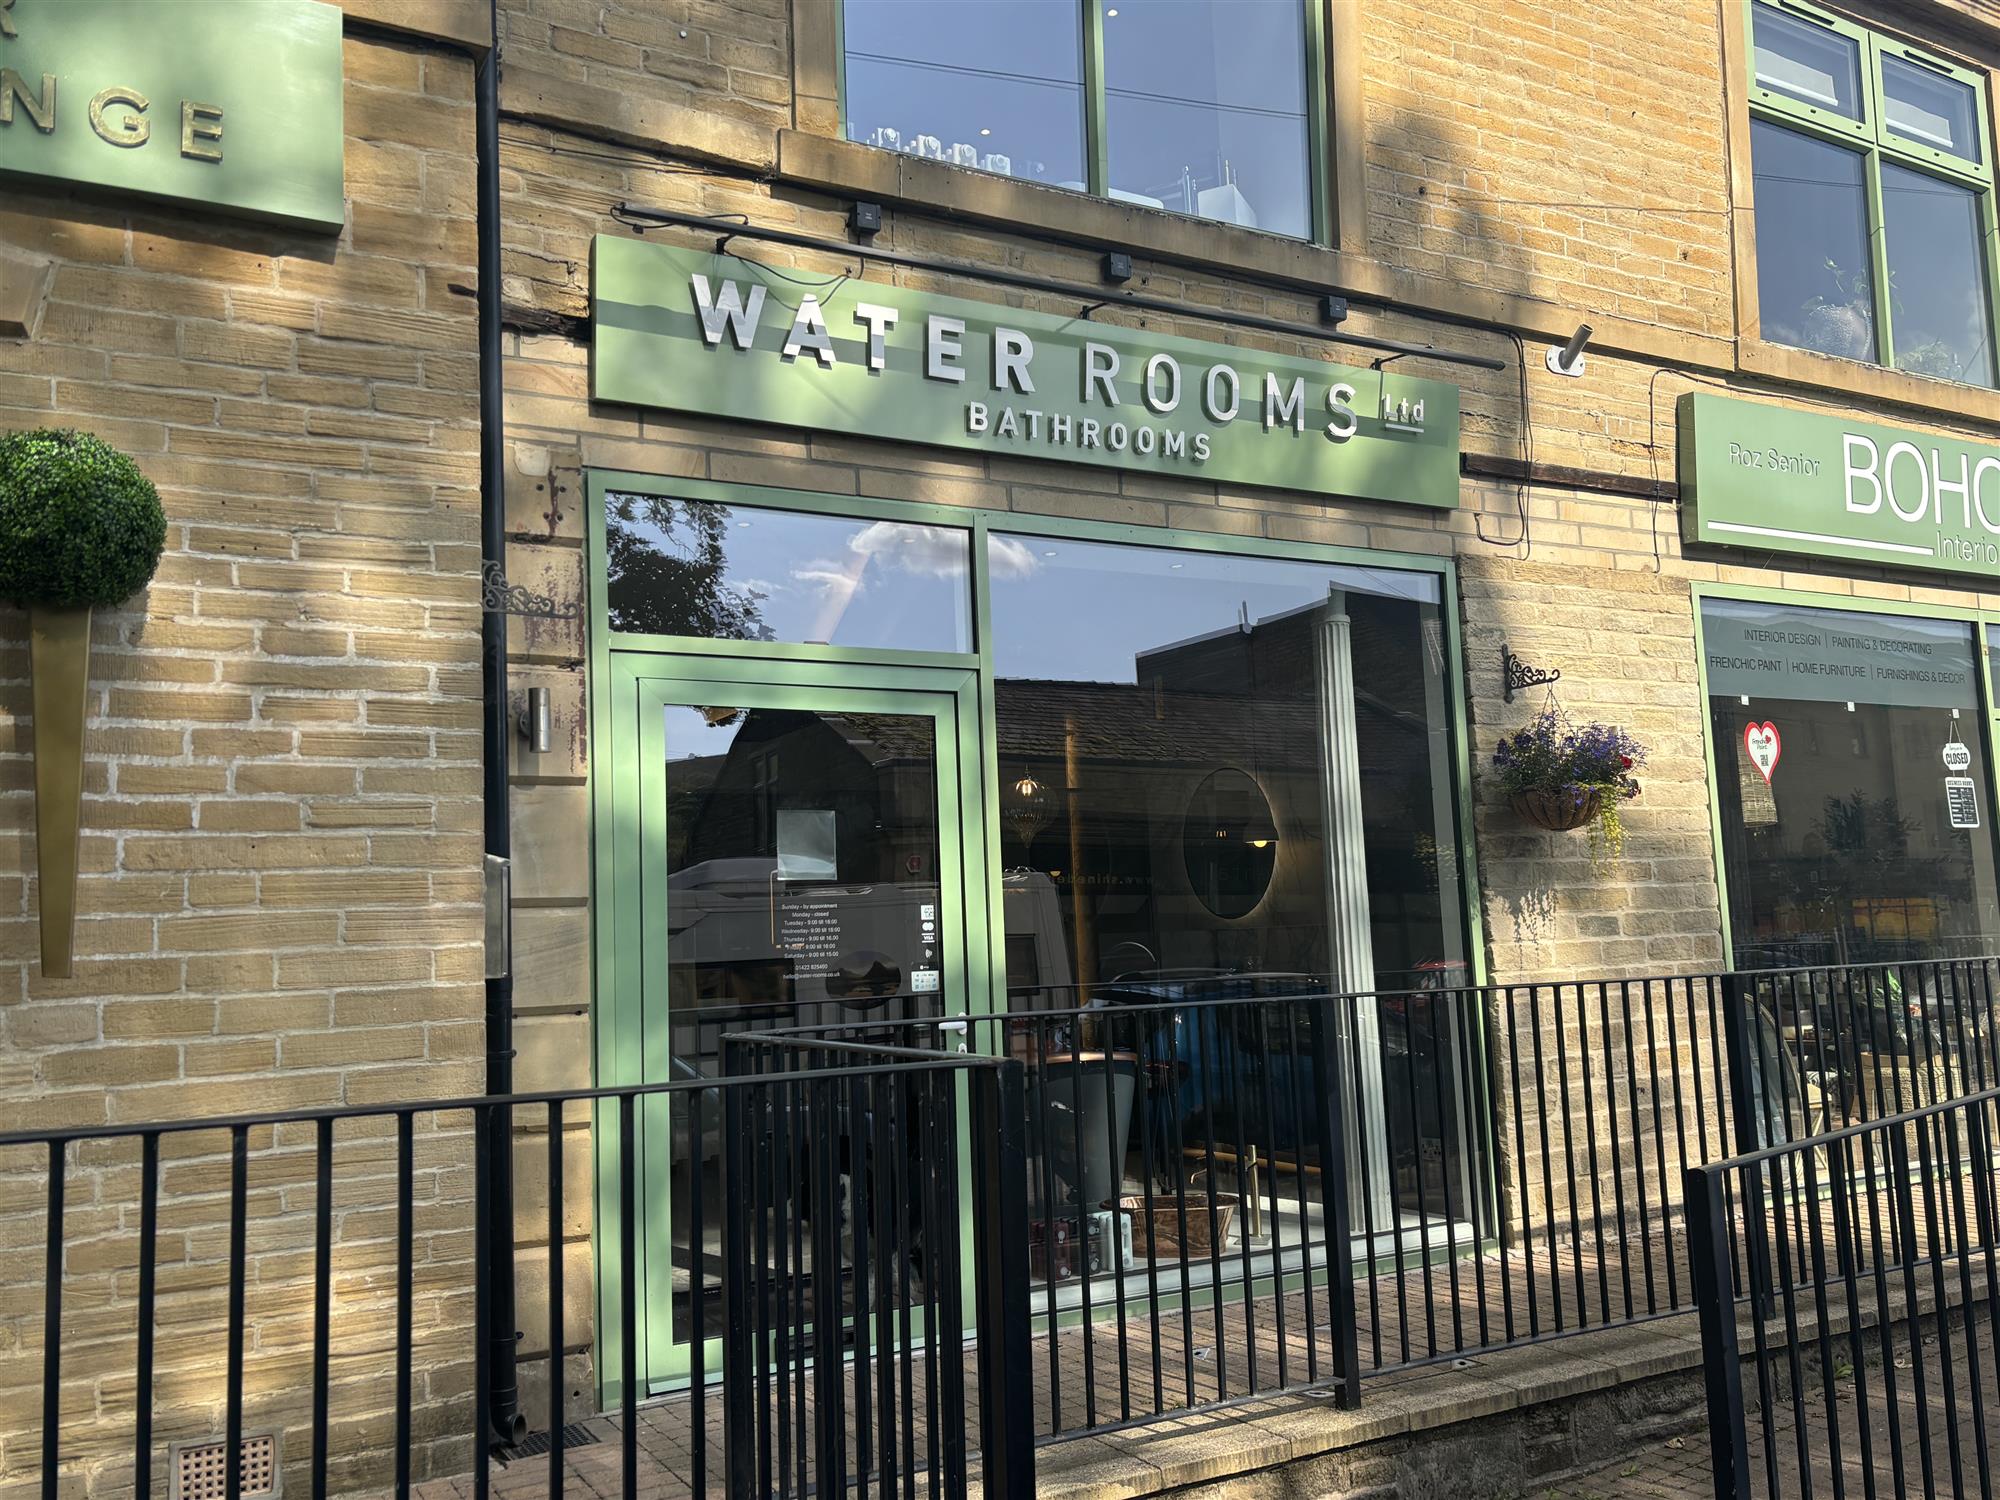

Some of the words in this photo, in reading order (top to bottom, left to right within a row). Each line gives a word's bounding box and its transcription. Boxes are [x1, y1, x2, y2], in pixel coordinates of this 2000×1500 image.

[690, 272, 1036, 393] WATER
[1083, 341, 1359, 441] ROOMS
[1383, 391, 1425, 423] Ltd
[969, 400, 1212, 462] BATHROOMS
[1729, 442, 1763, 469] Roz
[1767, 448, 1821, 477] Senior
[1744, 629, 1786, 644] INTERIOR
[1788, 633, 1821, 646] DESIGN
[1832, 636, 1870, 650] PAINTING
[1872, 640, 1878, 650] &
[1880, 641, 1932, 655] DECORATING
[1710, 656, 1756, 670] FRENCHIC
[1758, 658, 1782, 671] PAINT
[1792, 663, 1818, 675] HOME
[1819, 664, 1866, 677] FURNITURE
[1877, 669, 1930, 682] FURNISHINGS
[1931, 672, 1937, 683] &
[1938, 672, 1965, 684] DECOR
[1945, 753, 1969, 764] CLOSED
